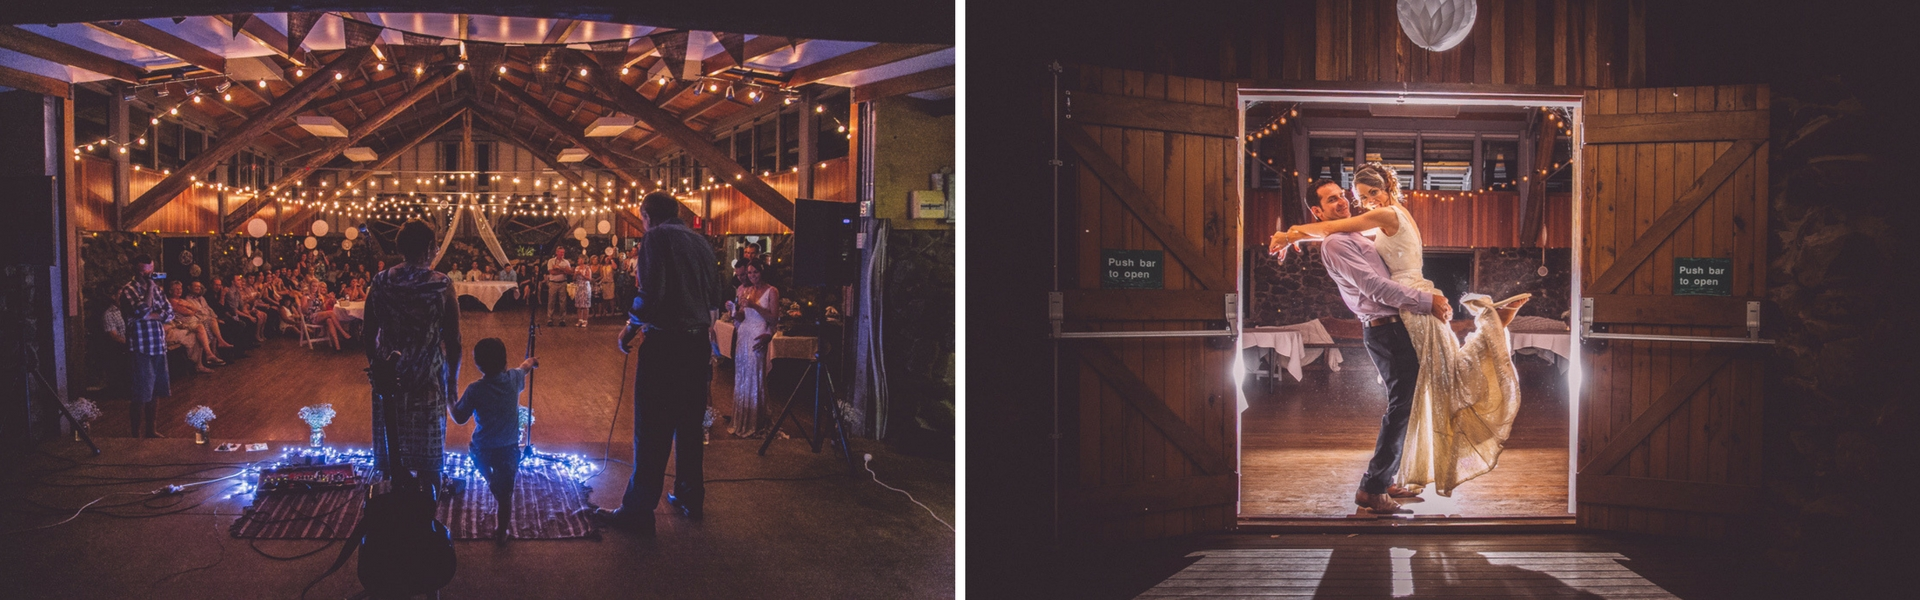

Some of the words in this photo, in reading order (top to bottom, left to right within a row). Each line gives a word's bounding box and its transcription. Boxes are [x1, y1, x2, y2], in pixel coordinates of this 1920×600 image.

[1109, 258, 1134, 267] Push
[1139, 259, 1156, 267] bar
[1109, 270, 1119, 278] to
[1124, 271, 1150, 279] open
[1679, 266, 1704, 274] Push
[1679, 277, 1689, 285] to
[1694, 278, 1718, 287] open
